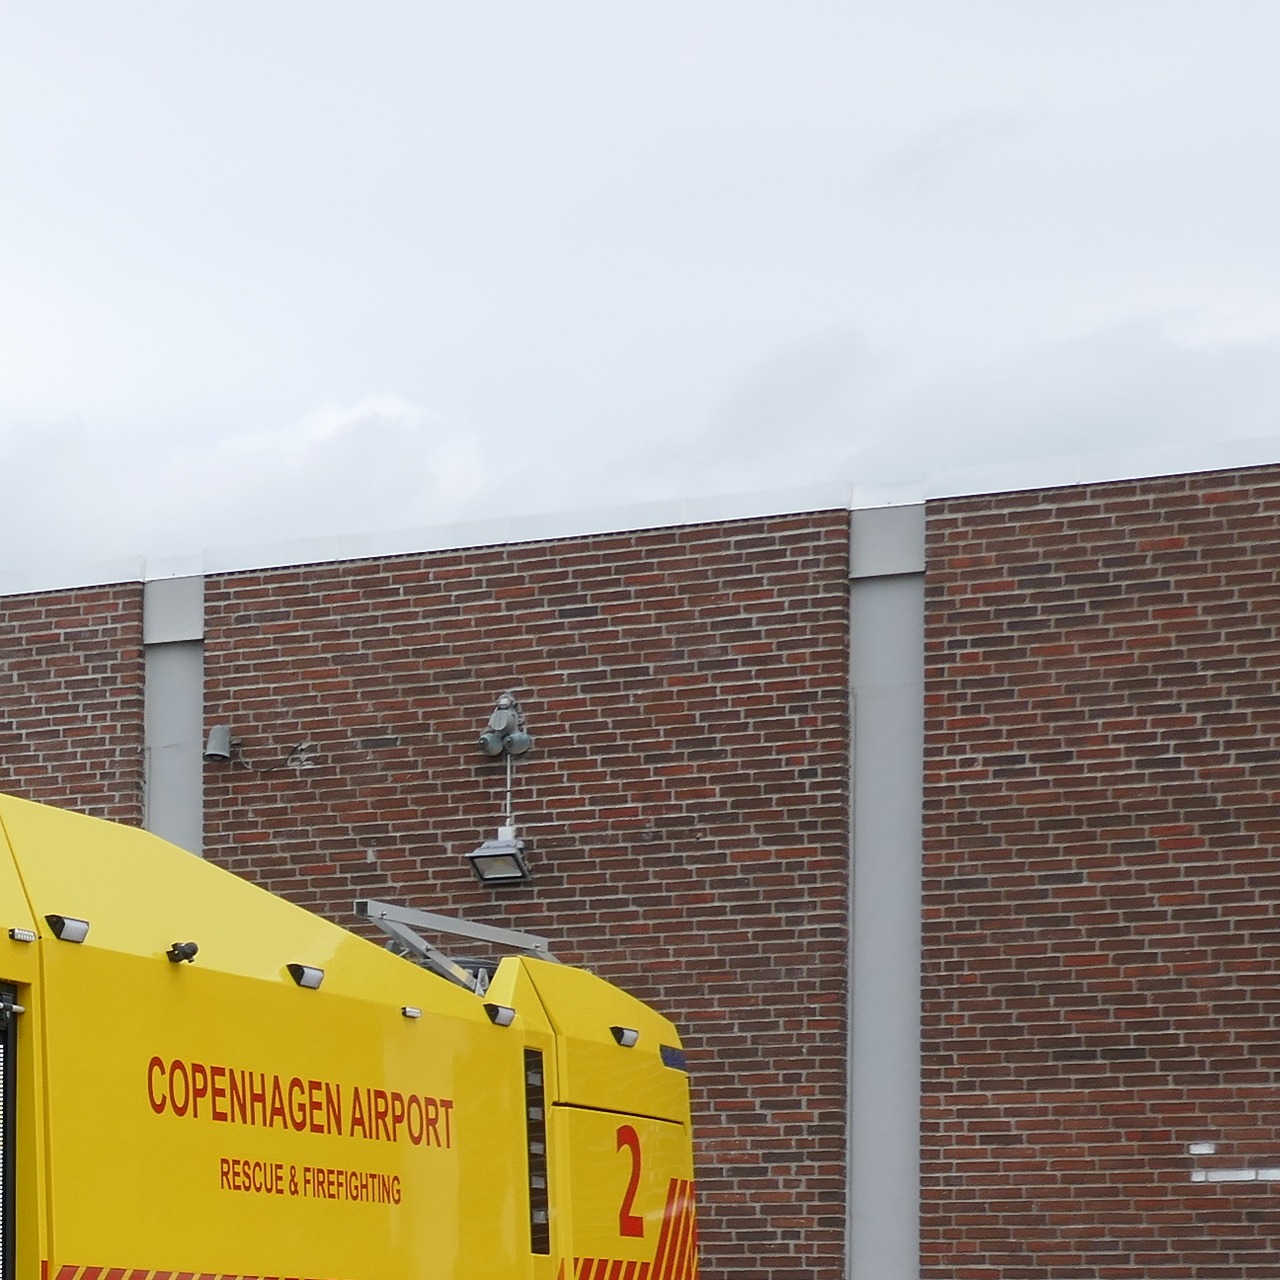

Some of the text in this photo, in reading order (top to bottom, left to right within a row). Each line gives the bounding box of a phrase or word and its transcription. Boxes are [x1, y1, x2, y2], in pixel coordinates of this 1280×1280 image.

[147, 1056, 454, 1149] COPENHAGEN AIRPORT
[220, 1158, 401, 1205] RESCUE & FIREFIGHTING
[616, 1125, 644, 1238] 2
